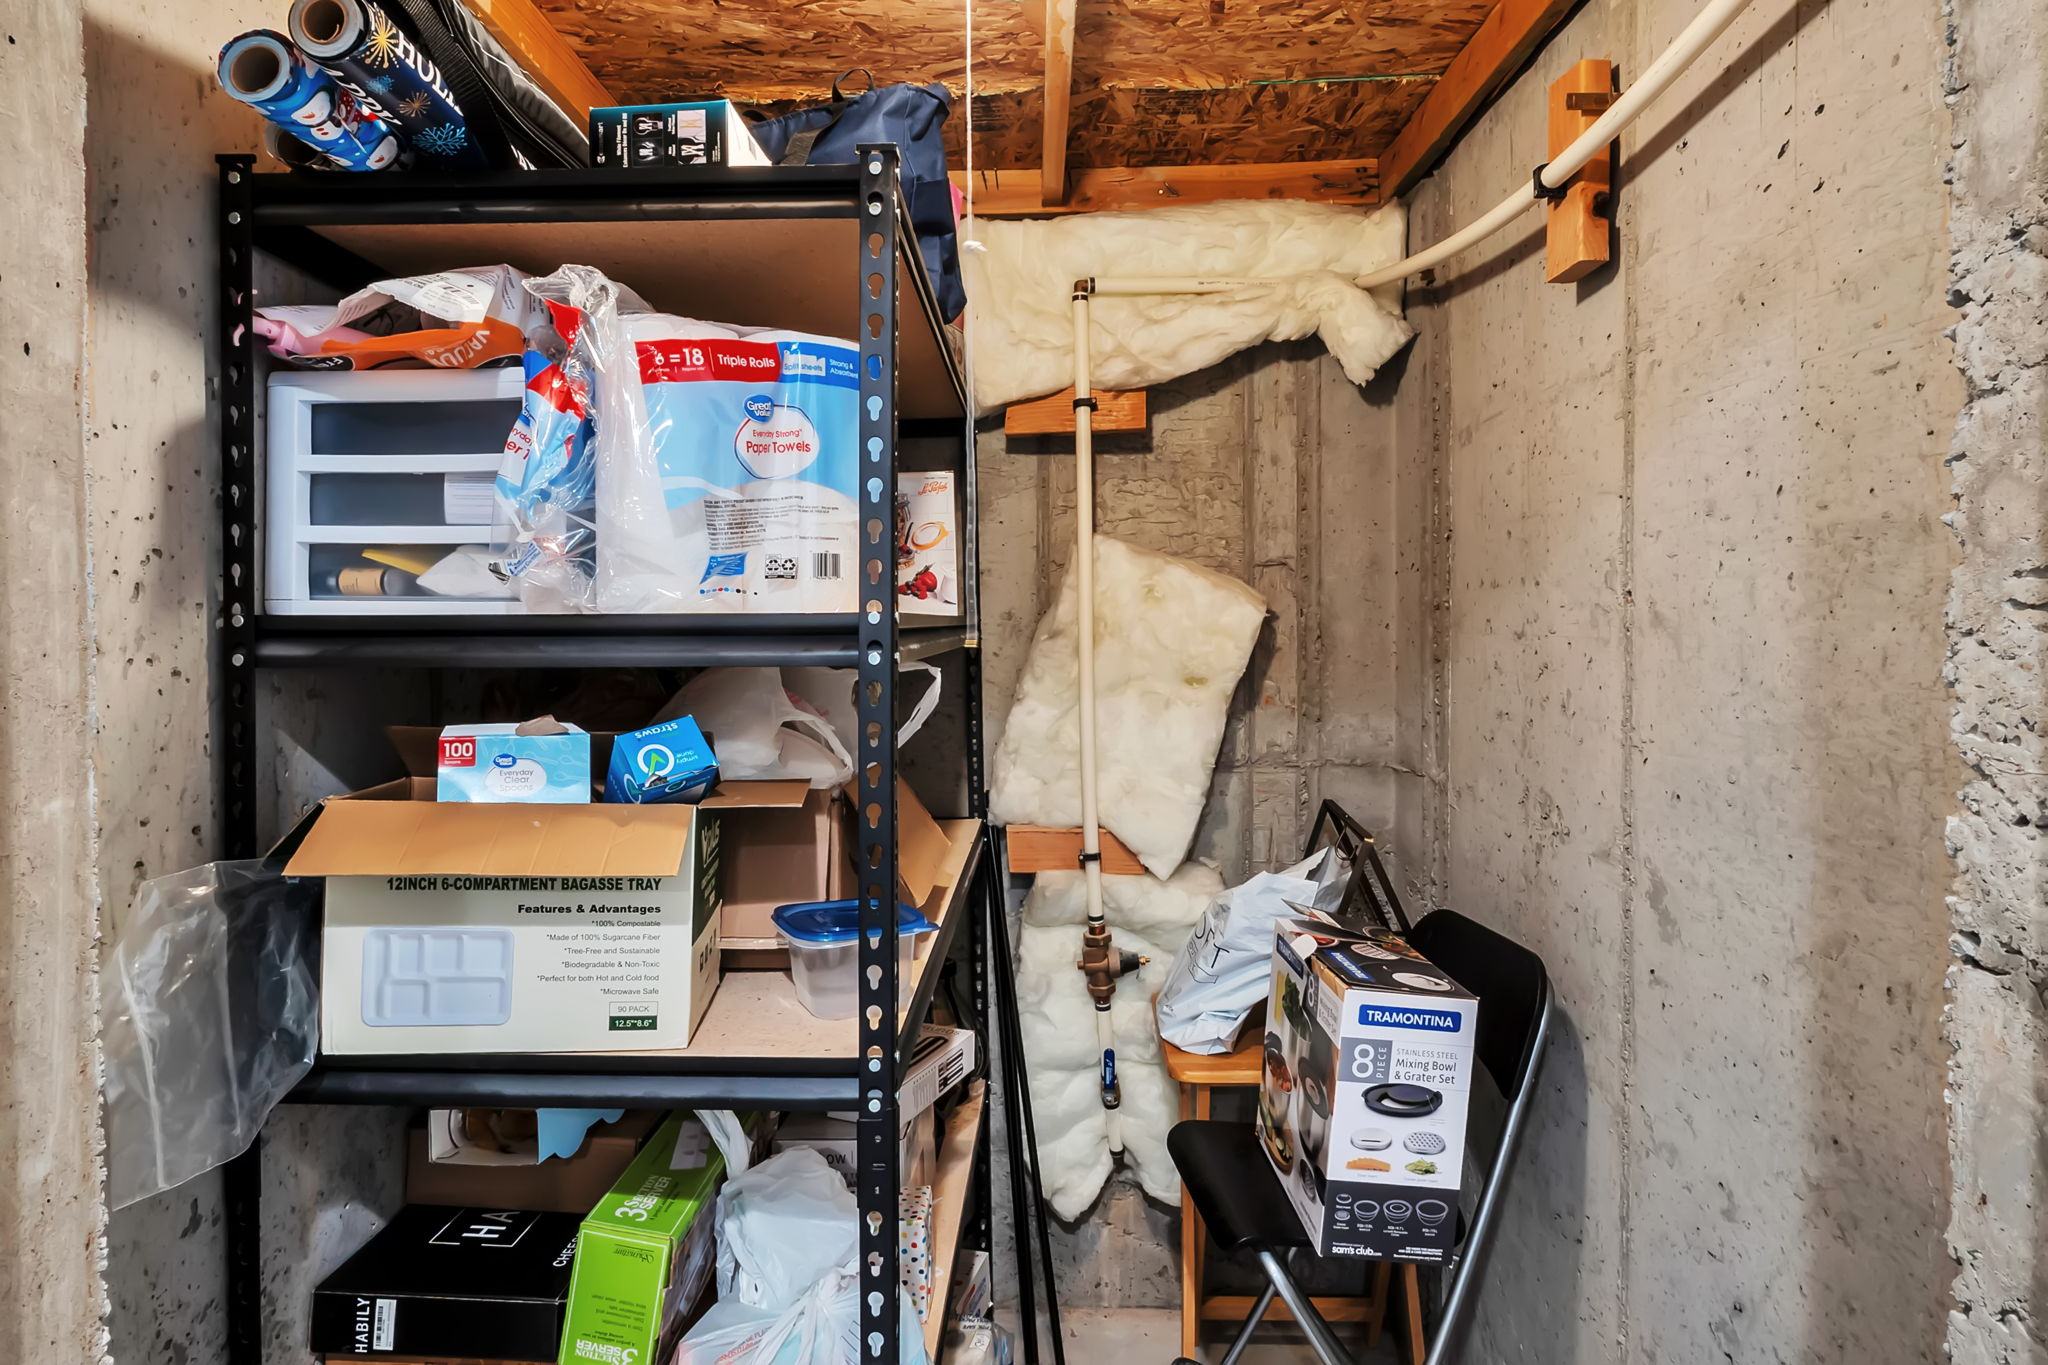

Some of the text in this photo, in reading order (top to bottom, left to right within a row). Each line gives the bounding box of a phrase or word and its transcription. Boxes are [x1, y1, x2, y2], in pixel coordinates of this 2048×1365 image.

[682, 348, 705, 366] 18
[717, 354, 776, 368] Triple Rolls
[830, 358, 848, 370] Strong
[747, 400, 771, 413] Great
[752, 429, 775, 440] Everyday
[746, 440, 811, 456] Paper Towels
[634, 722, 678, 740] straws
[444, 742, 474, 757] 100
[504, 776, 530, 784] Clear
[386, 877, 662, 892] 12INCH 6-COMPARTMENT BAGASSE TRAY
[518, 904, 662, 916] Features & Advantages
[616, 920, 661, 928] Compostable
[580, 934, 601, 942] 100%
[602, 934, 641, 943] Sugarcane
[643, 934, 661, 942] Fiber
[624, 960, 660, 968] Non-Toxic
[567, 974, 576, 982] for
[578, 974, 594, 982] both
[595, 974, 608, 982] Hot
[610, 974, 623, 982] and
[625, 974, 643, 982] Cold
[644, 974, 660, 982] food
[618, 1005, 627, 1013] 90
[1366, 1010, 1454, 1028] TRAMONTINA
[1352, 1044, 1375, 1078] 8
[1396, 1048, 1459, 1060] STAINLESS STEEL
[1376, 1046, 1388, 1079] PIECE
[1395, 1058, 1457, 1072] Mixing Bowl
[1394, 1072, 1455, 1084] & Grater Set
[639, 1176, 672, 1210] SERVER
[614, 1206, 648, 1222] 3
[354, 1297, 371, 1353] HABILY
[576, 1338, 625, 1354] SERVER
